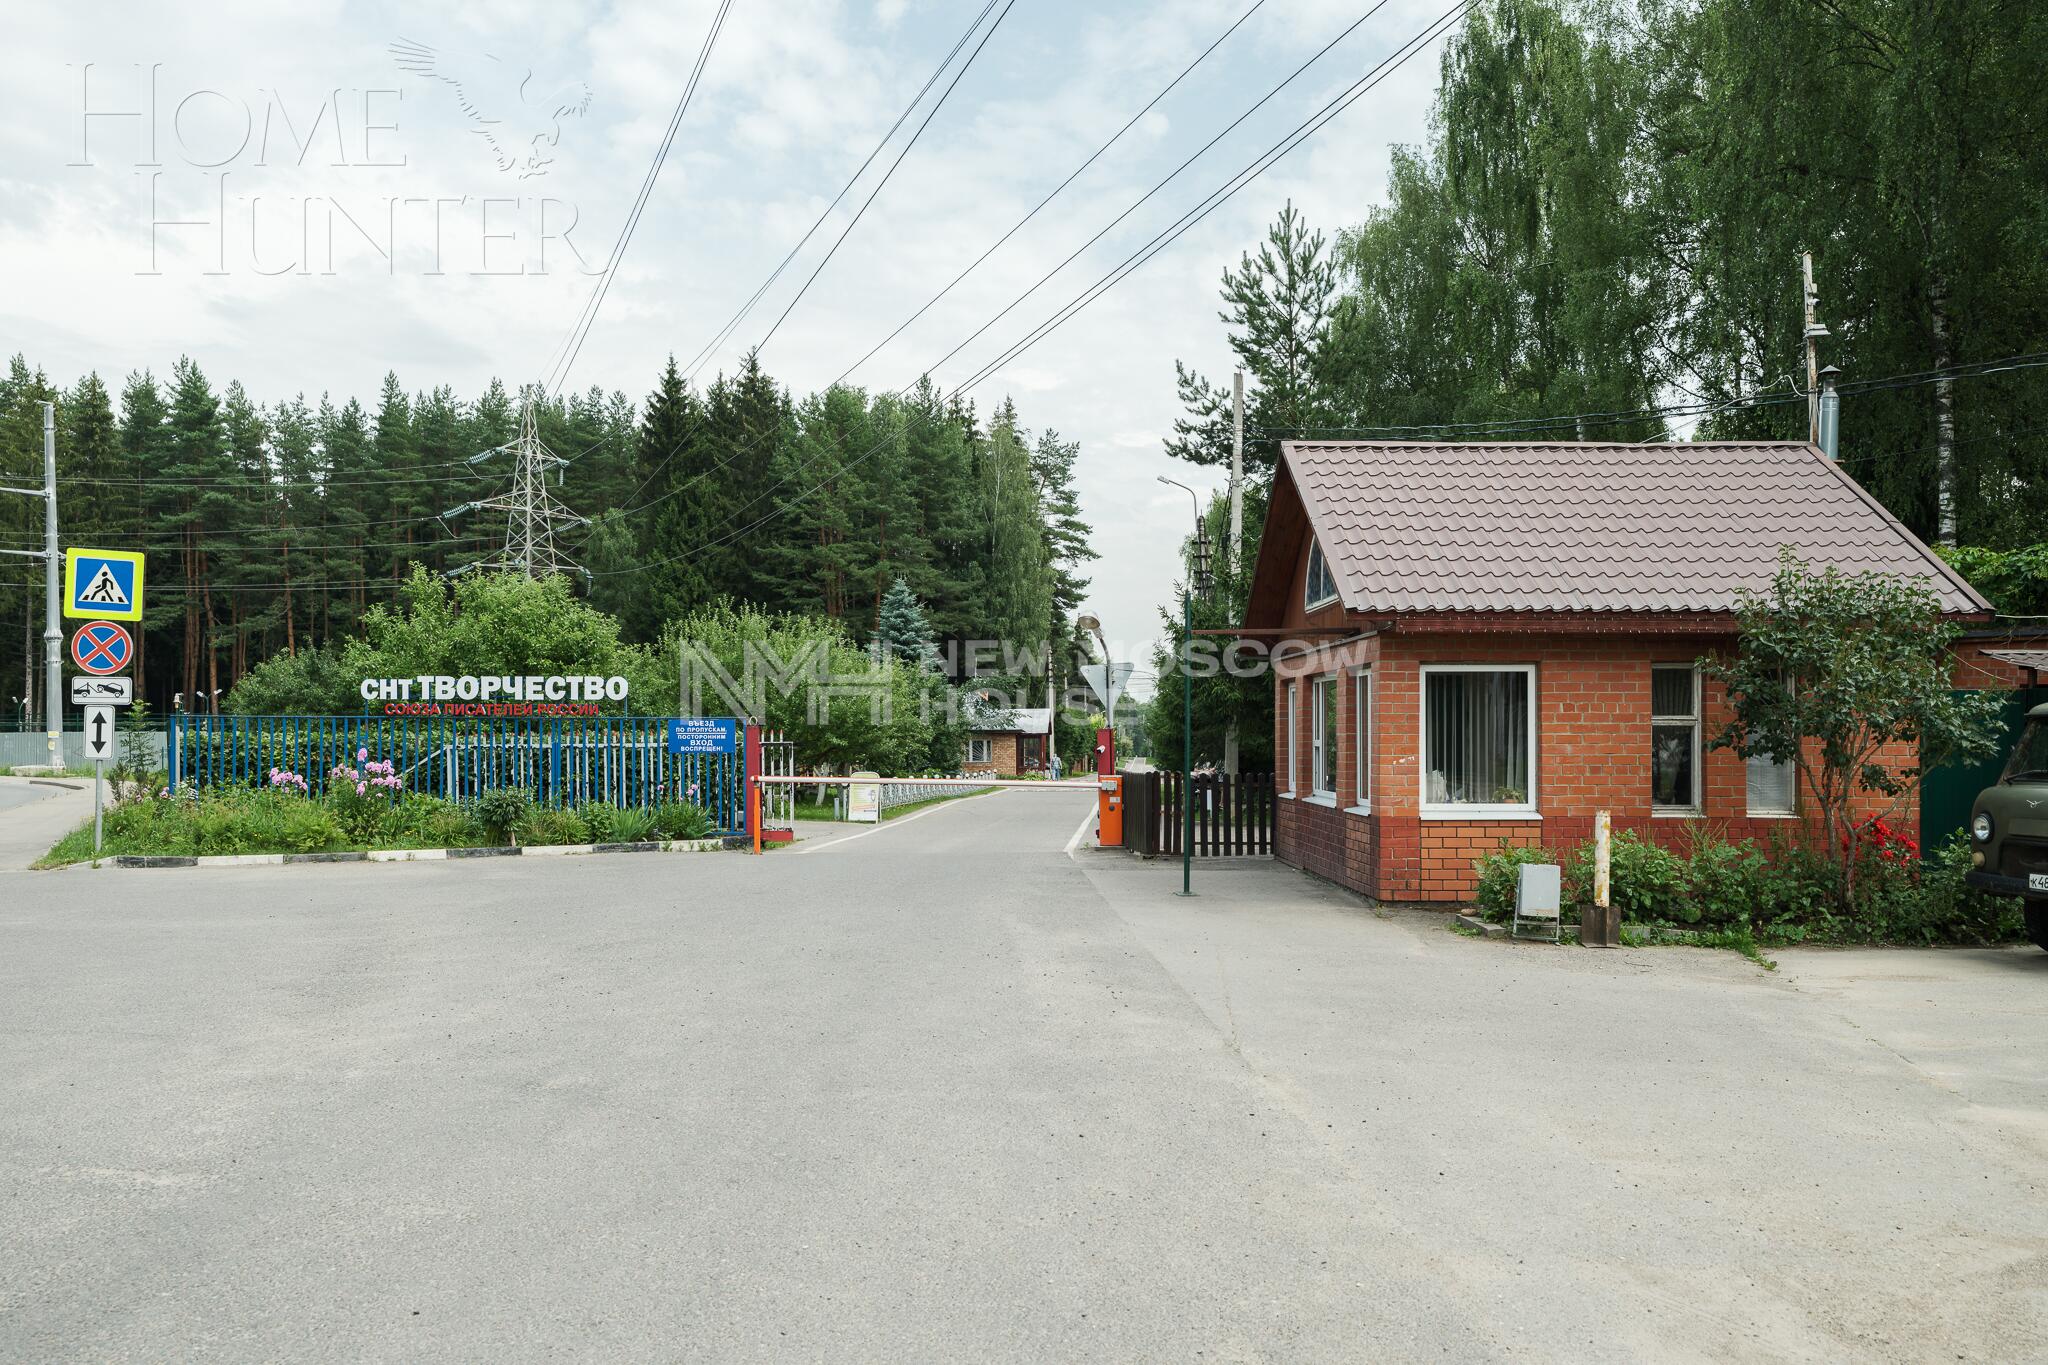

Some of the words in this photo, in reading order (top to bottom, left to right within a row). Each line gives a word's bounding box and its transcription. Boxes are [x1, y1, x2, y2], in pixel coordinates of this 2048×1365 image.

[360, 678, 413, 700] СНТ
[417, 675, 629, 700] ТВОРЧЕСТВО
[384, 703, 441, 716] СОЮЗА
[443, 703, 533, 716] ПИСАТЕЛЕЙ
[537, 703, 599, 716] РОССИИ
